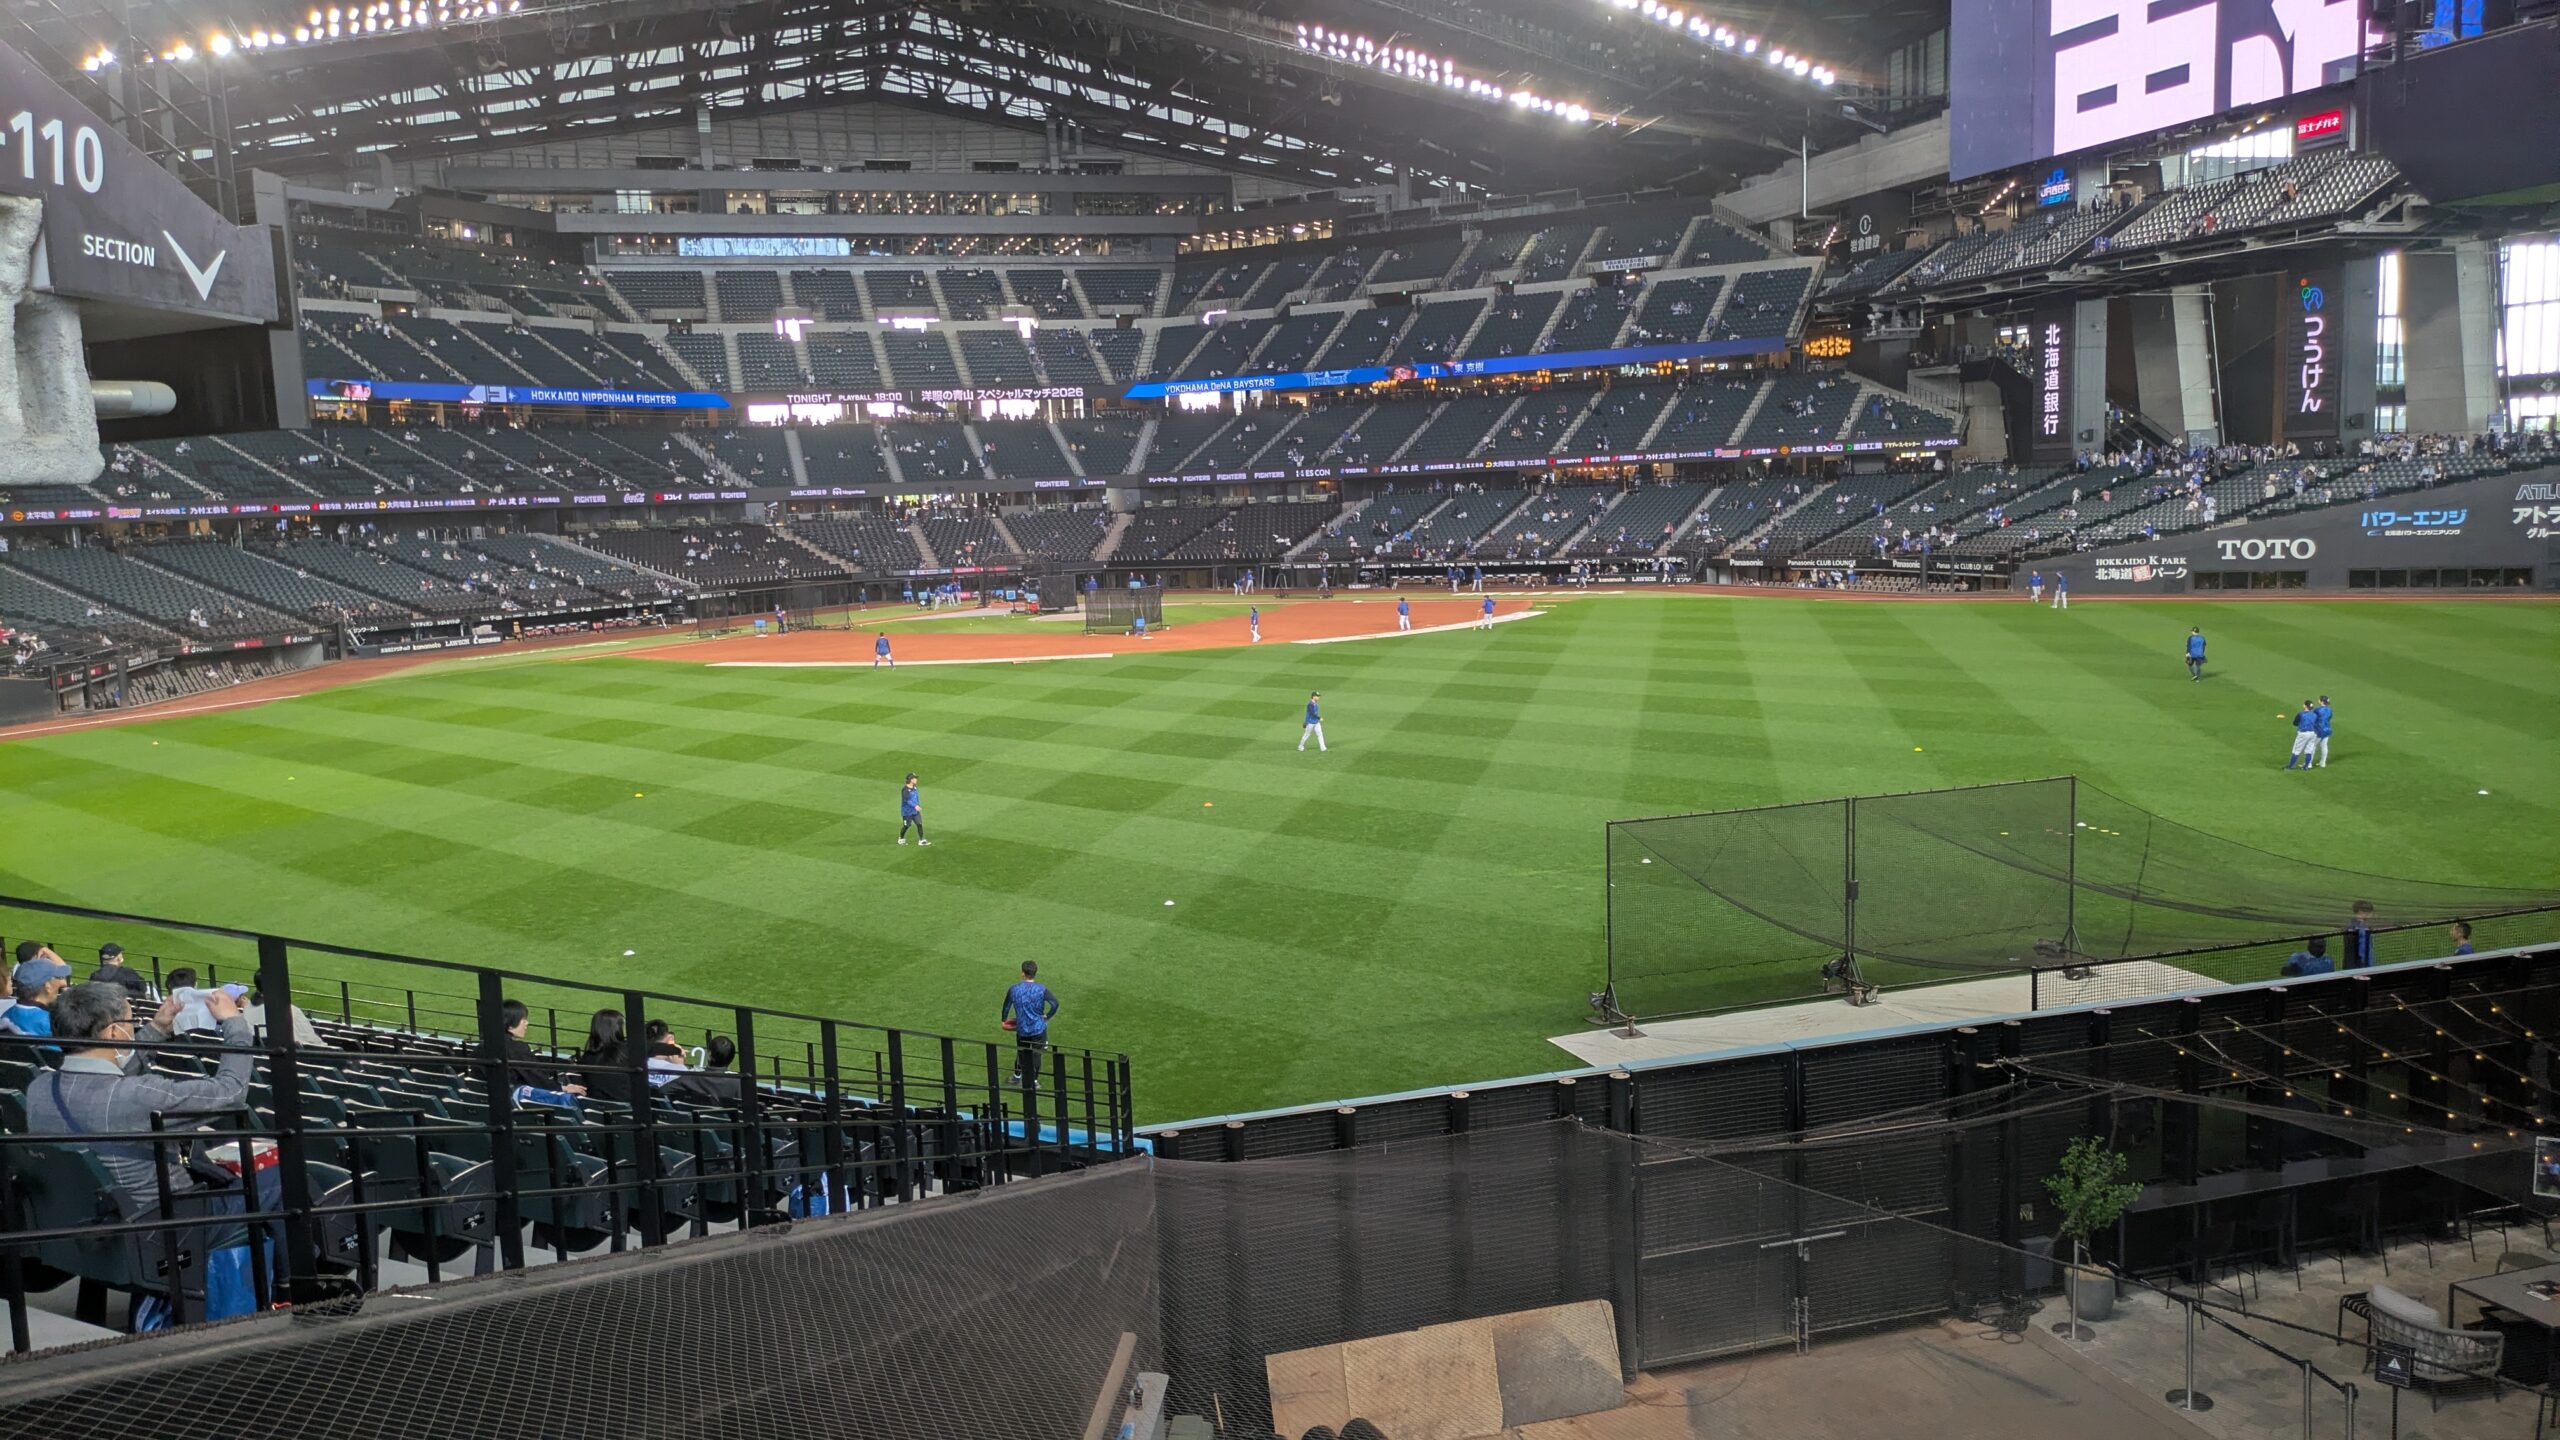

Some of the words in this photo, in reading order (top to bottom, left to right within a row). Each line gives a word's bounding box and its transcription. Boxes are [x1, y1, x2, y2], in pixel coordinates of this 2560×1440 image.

[2298, 116, 2339, 134] 富士メガネ
[2040, 182, 2071, 198] JR西日本
[83, 234, 155, 267] SECTION
[1431, 365, 1440, 375] 11
[2301, 316, 2323, 413] つうけん
[2044, 323, 2060, 435] 北海道銀行
[1165, 382, 1209, 393] YOKOHAMA
[1211, 381, 1232, 391] DeNA
[1233, 378, 1275, 389] BAYSTARS
[531, 390, 579, 401] HOKKAIDO
[582, 391, 634, 404] NIPPONHAM
[636, 394, 677, 405] FIGHTERS
[787, 393, 832, 403] TONIGHT
[838, 393, 872, 401] PLAYBALL
[874, 392, 903, 402] 18:00
[921, 389, 974, 402] 洋服の青山
[977, 387, 1084, 400] スペシャルマッチ2026
[1183, 474, 1211, 482] FIGHTERS
[1217, 473, 1246, 481] FIGHTERS
[1254, 471, 1285, 479] FIGHTERS
[1035, 480, 1070, 488] FIGHTERS
[721, 491, 747, 499] FIGHTERS
[2515, 483, 2560, 501] ATL
[574, 494, 606, 504] FIGHTERS
[2361, 509, 2467, 527] パワーエンジ
[2217, 538, 2316, 560] TOTO
[1729, 558, 1764, 567] Panasonic
[1816, 558, 1831, 566] CLUB
[1832, 559, 1857, 567] LOUNGE
[1893, 559, 1921, 568] Panasonic
[1936, 561, 1959, 570] Panasic
[1960, 562, 1973, 570] CLUB
[2096, 558, 2147, 566] HOKKAIDO
[2148, 555, 2159, 565] K
[2161, 557, 2188, 565] PARK
